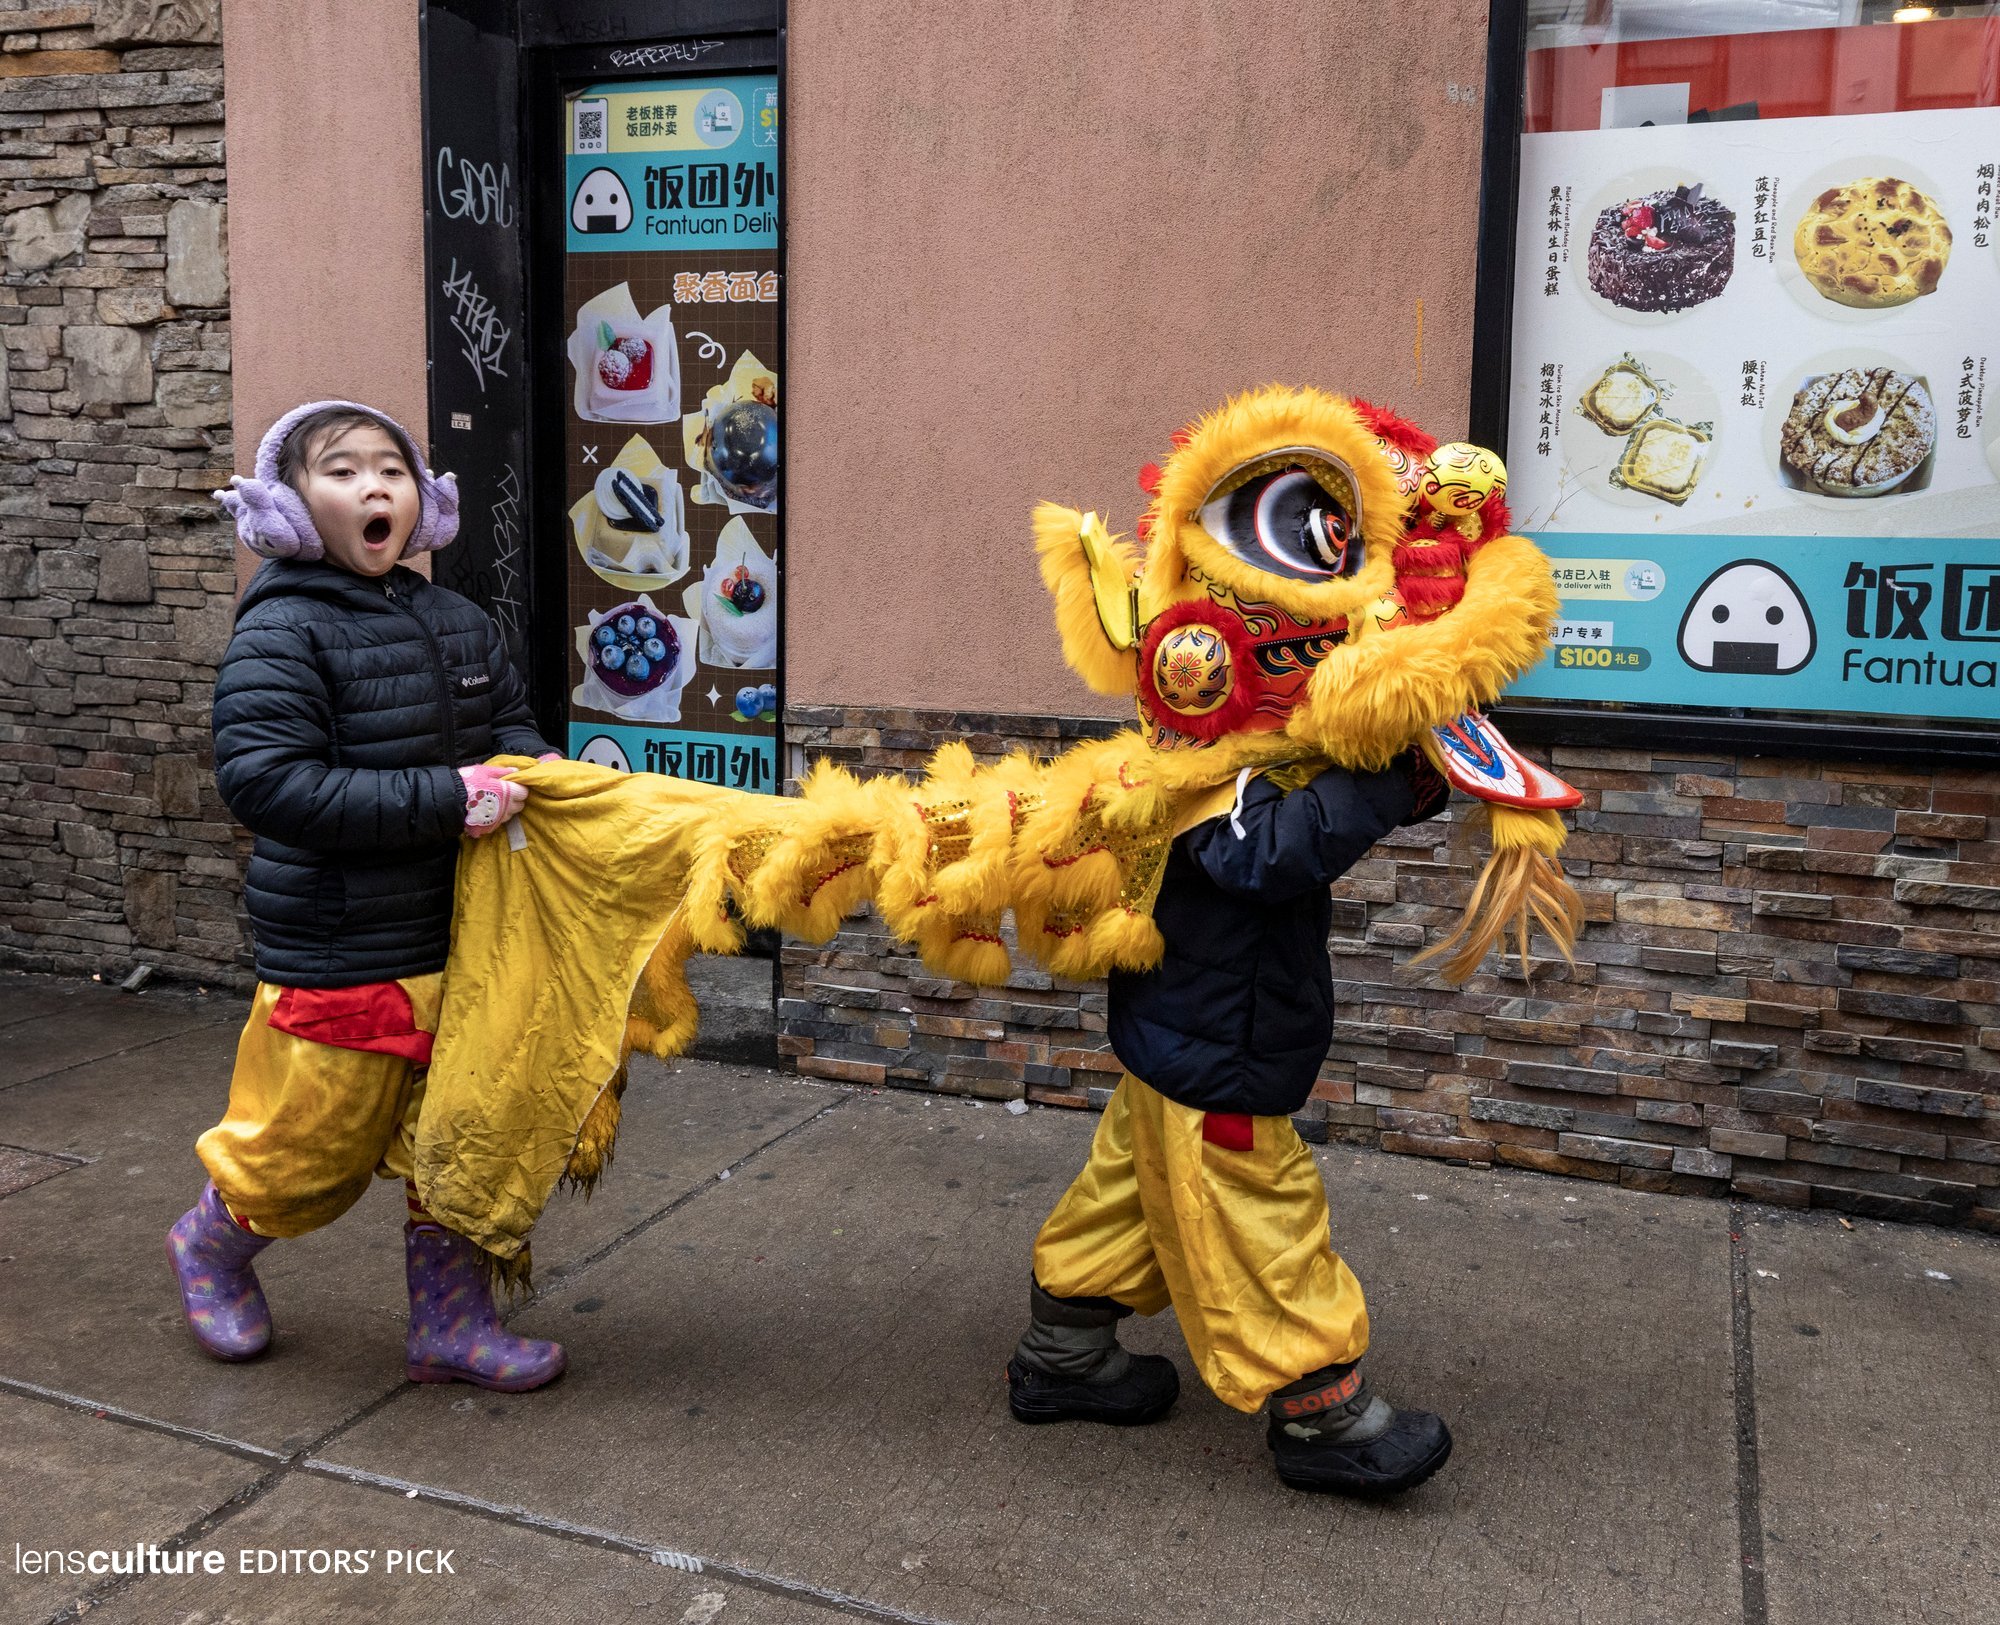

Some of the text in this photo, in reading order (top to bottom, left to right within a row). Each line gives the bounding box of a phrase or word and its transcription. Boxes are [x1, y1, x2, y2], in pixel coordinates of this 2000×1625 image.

[626, 104, 678, 121] 老板推荐
[626, 121, 678, 137] 饭团外卖
[644, 162, 775, 210] 饭团外
[1771, 177, 1780, 207] Pineapple
[1752, 176, 1770, 258] 菠萝红豆包
[1973, 163, 1995, 248] 烟肉肉松包
[645, 215, 727, 235] Fantuan
[1544, 185, 1563, 297] 黑森林生日蛋糕
[673, 270, 778, 303] 聚香面包
[1741, 360, 1758, 406] 腰果挞
[1978, 357, 1987, 381] Desktop
[1536, 363, 1555, 457] 榴莲冰皮月饼
[1956, 356, 1976, 439] 台式菠萝包
[1975, 383, 1985, 414] Pineapple
[1552, 569, 1611, 581] 本店已入驻
[1564, 581, 1592, 590] deliver
[1594, 582, 1612, 590] with
[1560, 646, 1640, 667] $100 礼包
[1842, 648, 1998, 688] Fantua
[644, 738, 770, 789] 饭团外
